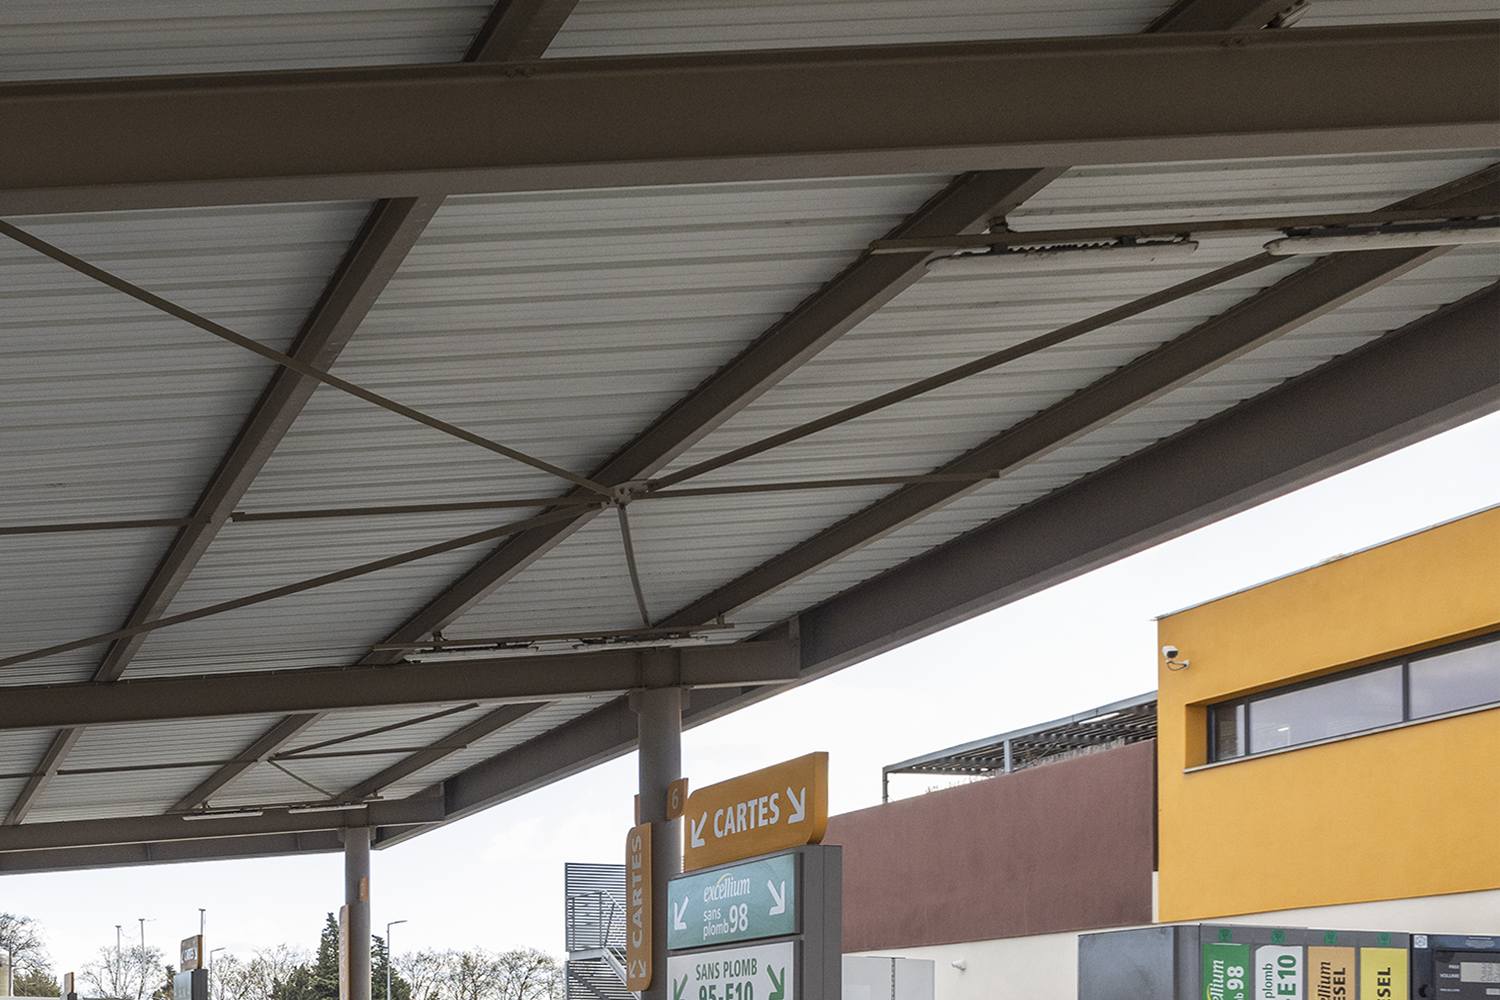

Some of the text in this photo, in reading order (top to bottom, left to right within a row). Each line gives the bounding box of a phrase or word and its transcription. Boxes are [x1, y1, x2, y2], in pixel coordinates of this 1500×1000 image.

[672, 788, 678, 810] 6
[714, 793, 780, 838] CARTES
[632, 834, 642, 947] CARTES
[704, 876, 750, 902] excellium
[703, 908, 721, 922] sans
[703, 903, 748, 940] plomb 98
[696, 958, 758, 981] SANS PLOMB
[1226, 966, 1244, 990] 98
[1262, 963, 1276, 998] plomb
